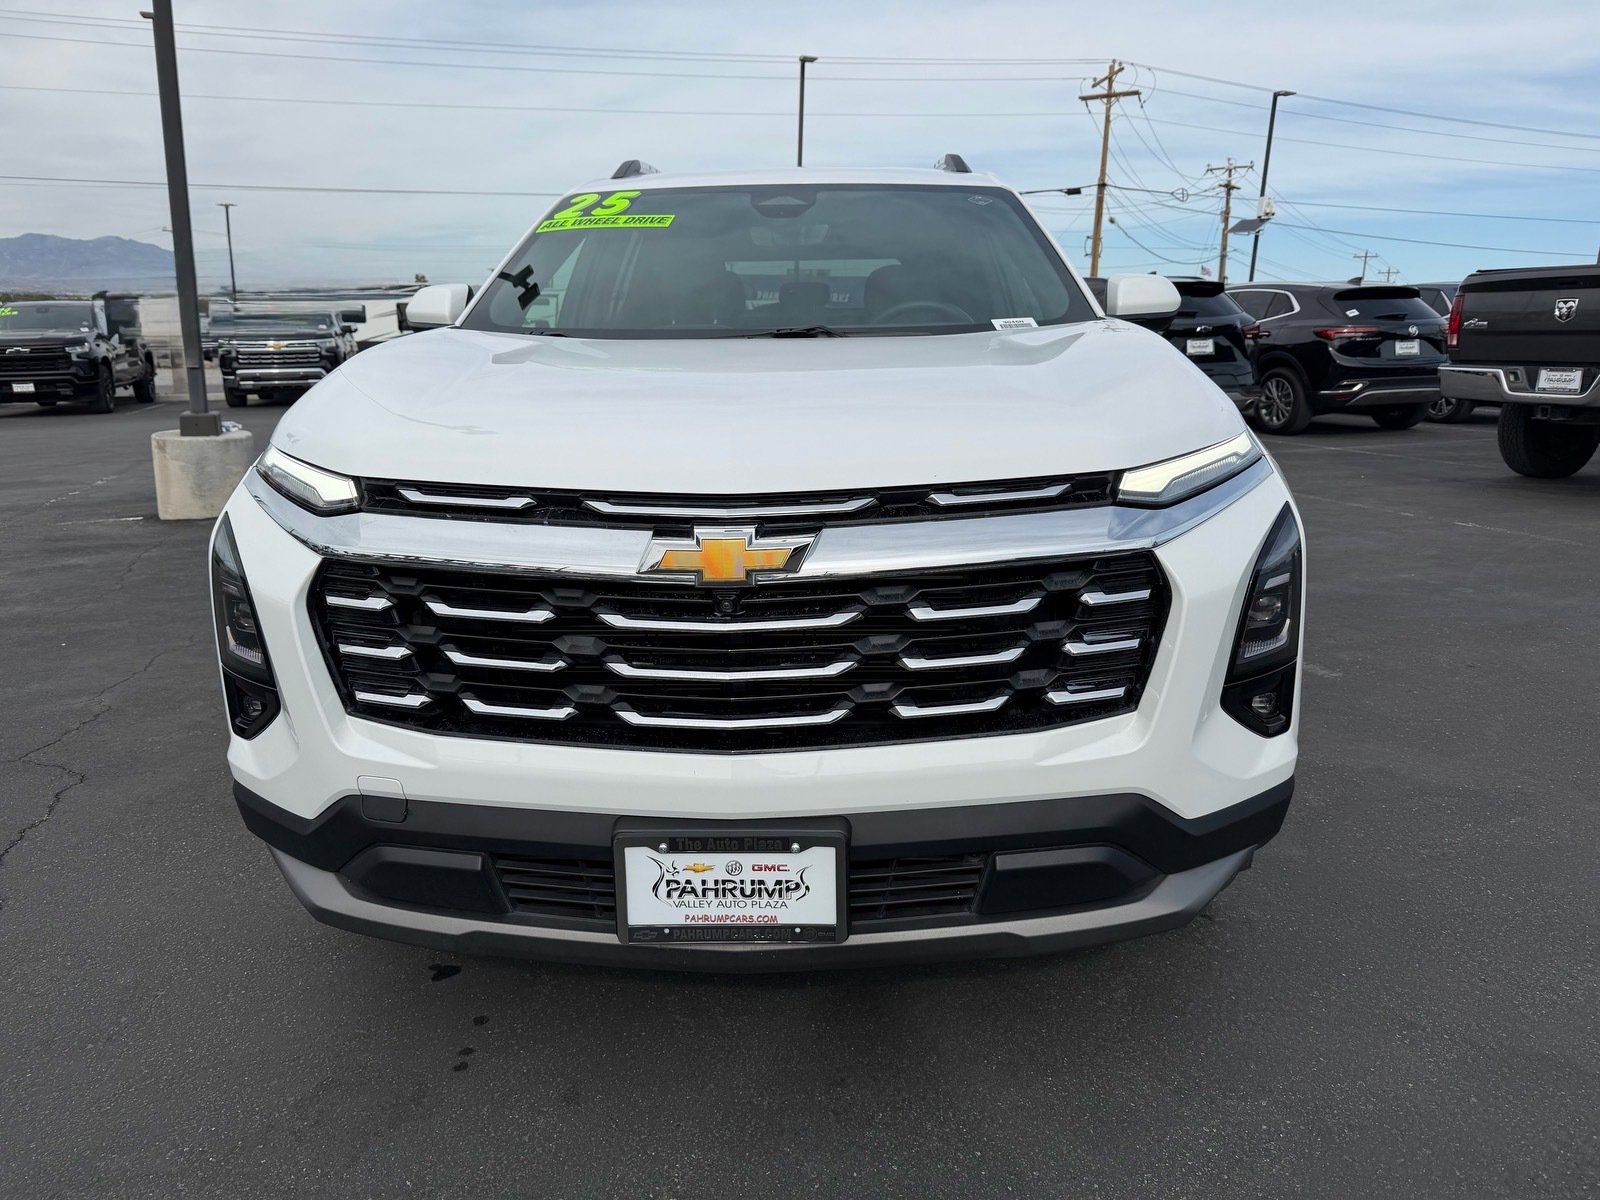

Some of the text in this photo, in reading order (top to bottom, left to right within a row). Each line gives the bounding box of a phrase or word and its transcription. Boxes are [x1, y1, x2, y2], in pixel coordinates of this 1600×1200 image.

[553, 190, 642, 219] 25
[541, 215, 671, 230] ALL WHEEL DRIVE
[675, 838, 783, 851] The Auto Plaza
[751, 864, 788, 872] GMC
[665, 879, 802, 900] PAHRUMP
[673, 900, 789, 909] VALLEY AUTO PLAZA
[684, 914, 779, 923] PAHRUMPCARS.COM
